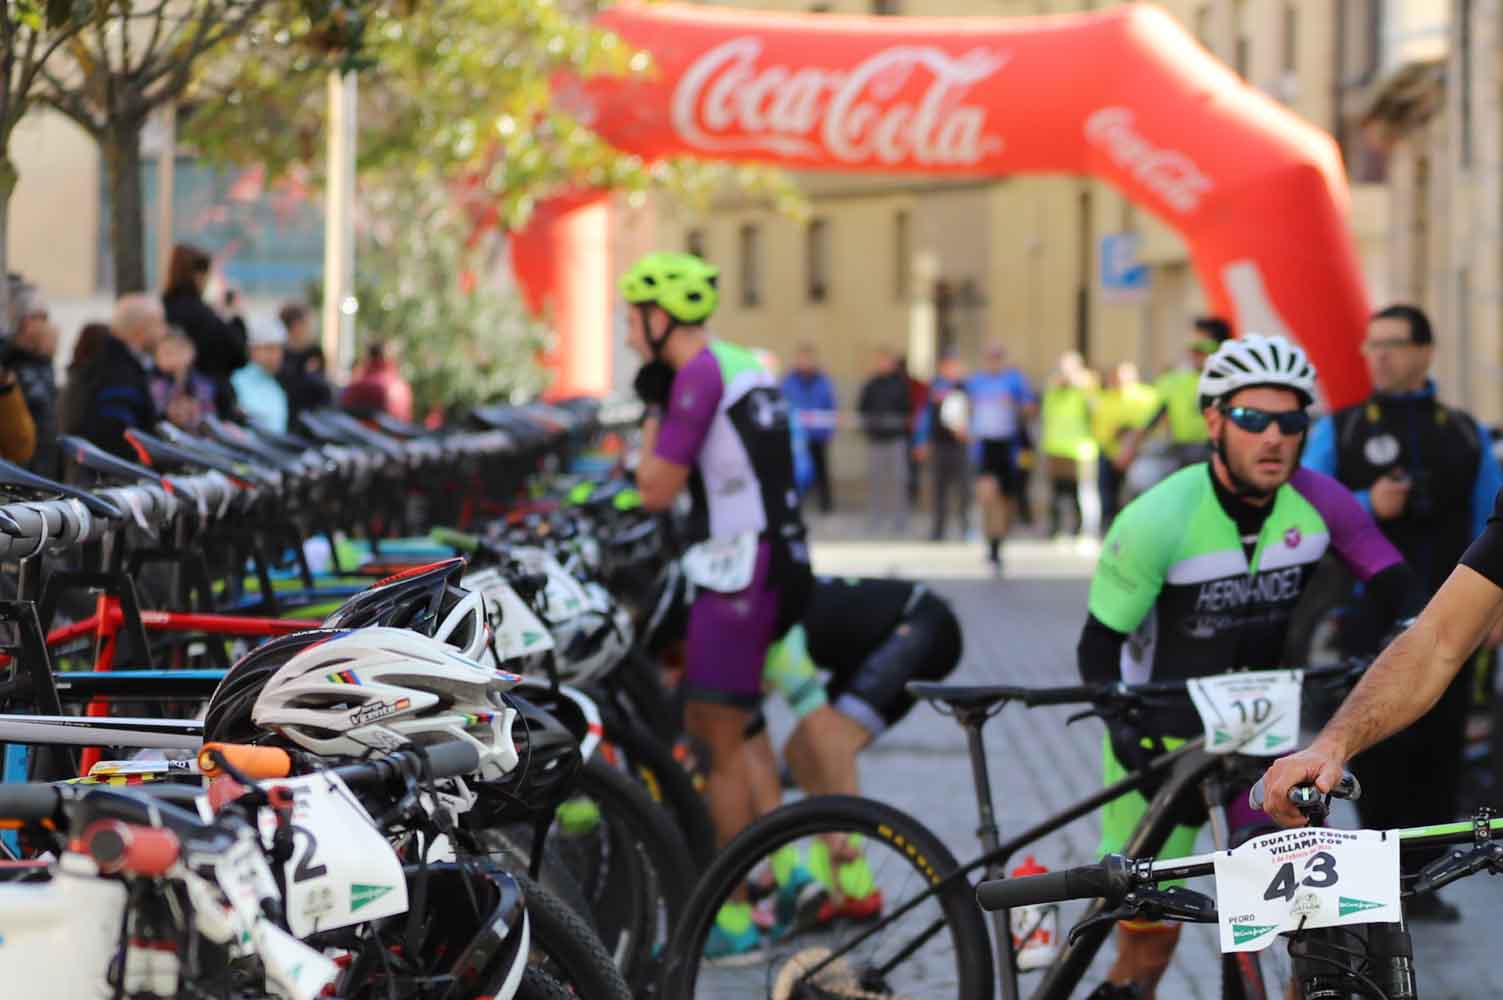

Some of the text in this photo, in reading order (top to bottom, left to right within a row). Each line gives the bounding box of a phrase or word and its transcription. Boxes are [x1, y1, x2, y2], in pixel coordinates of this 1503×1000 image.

[671, 36, 1008, 163] Coca-Cola
[1260, 831, 1317, 847] DUATLON
[1270, 838, 1342, 855] VILLAMAYOR
[1263, 851, 1339, 902] 43
